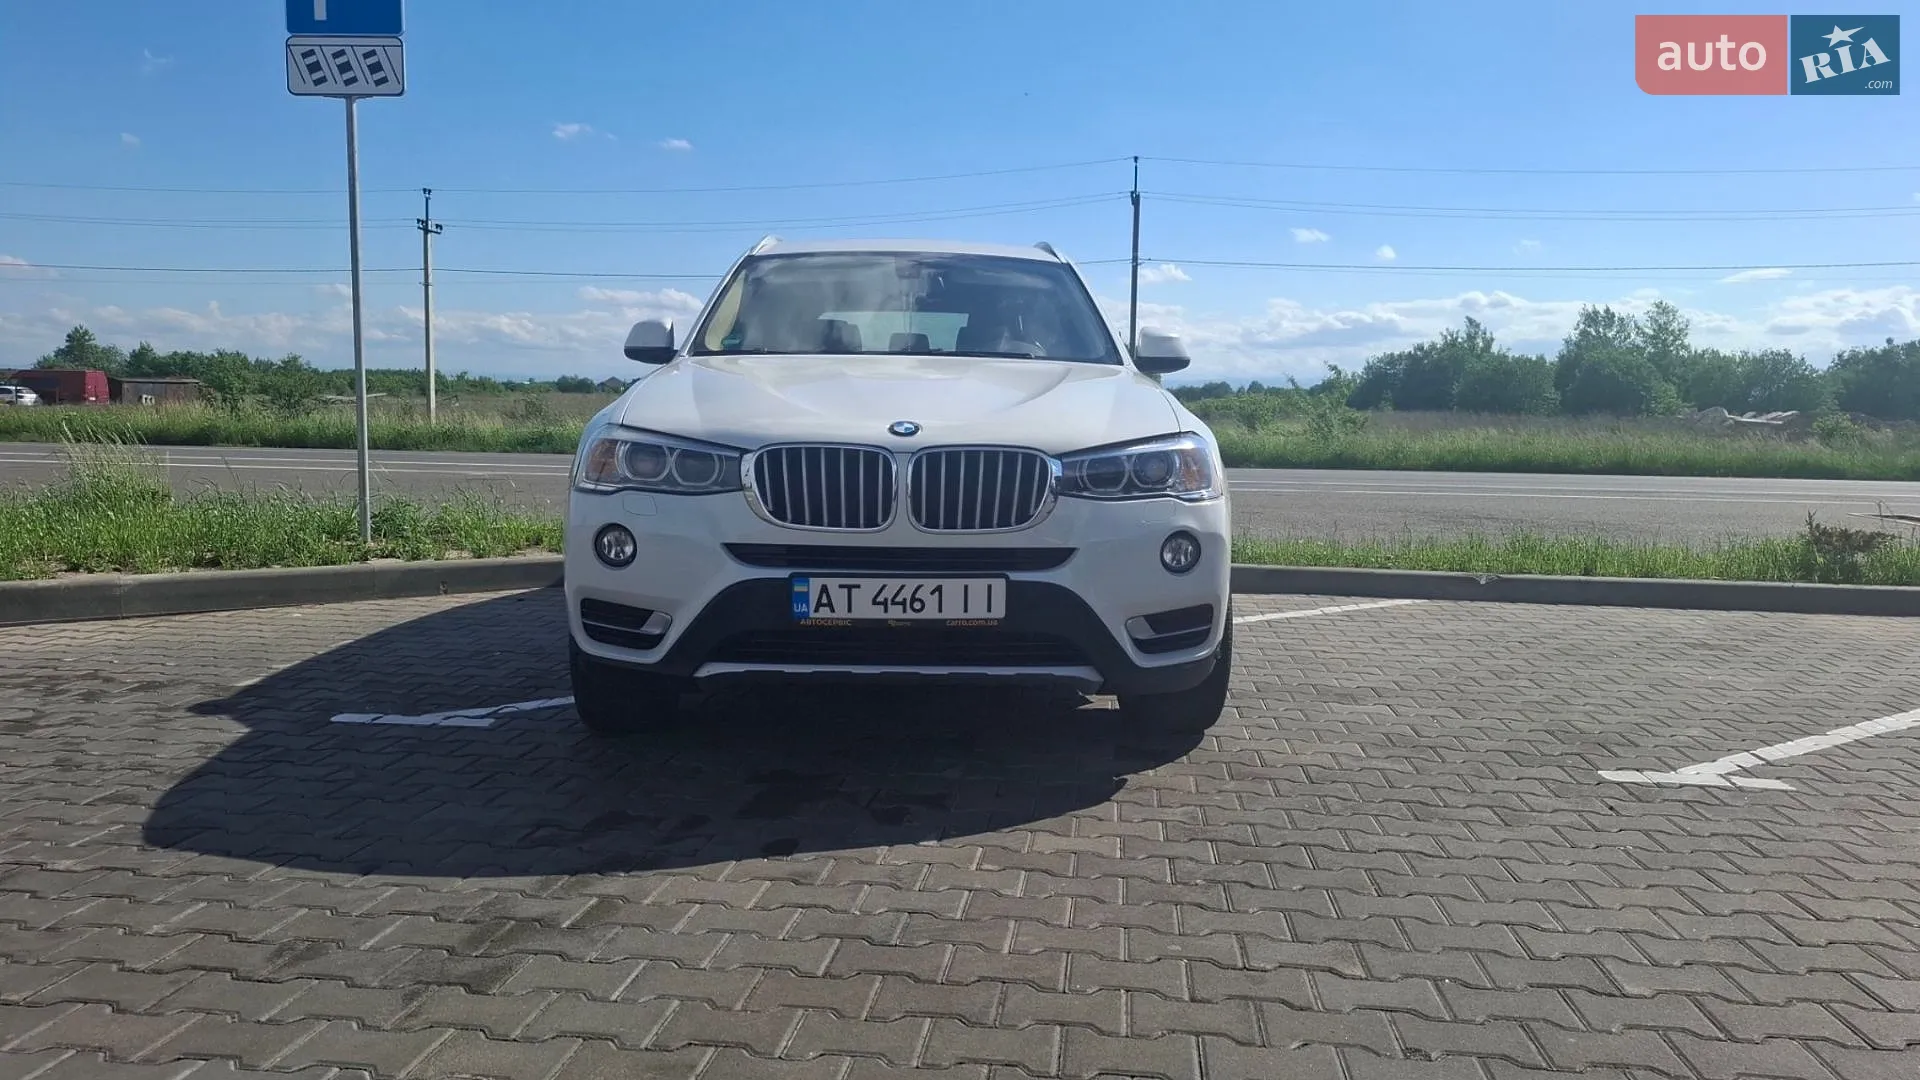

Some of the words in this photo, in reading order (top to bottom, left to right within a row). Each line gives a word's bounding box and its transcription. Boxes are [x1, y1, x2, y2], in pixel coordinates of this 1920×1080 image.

[794, 603, 809, 614] UA
[813, 584, 861, 614] AT
[871, 584, 944, 614] 4461
